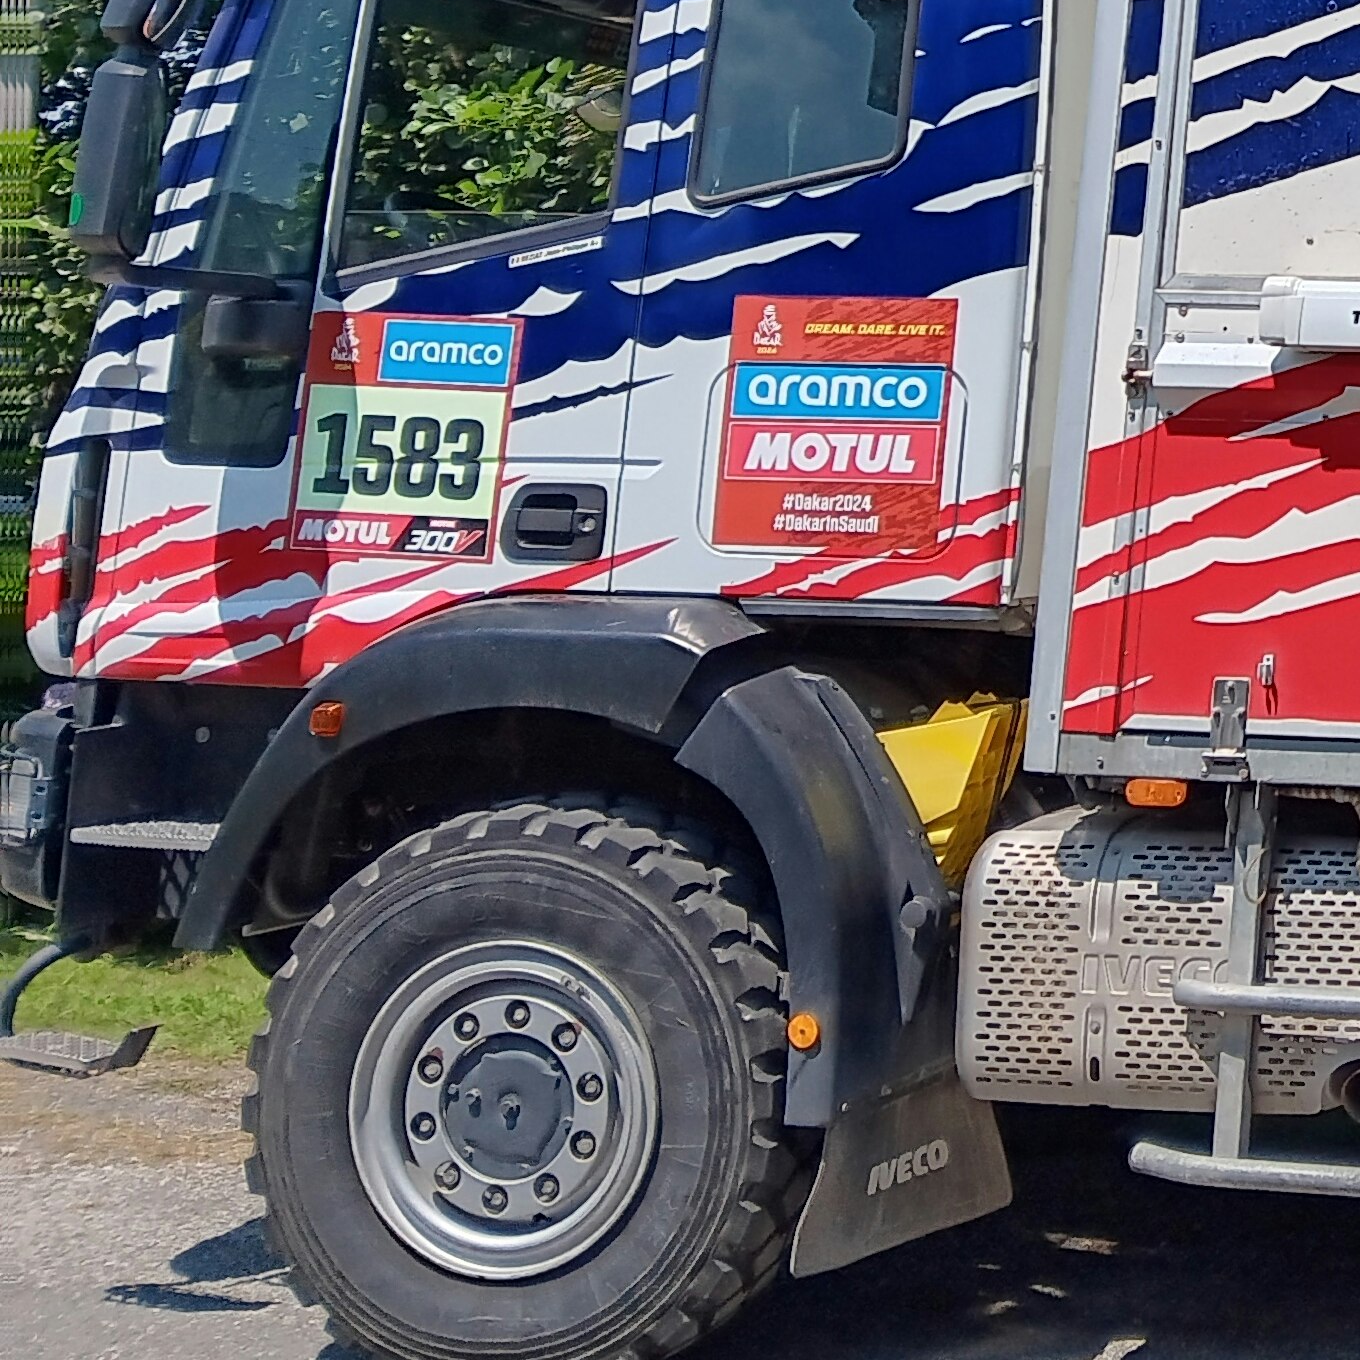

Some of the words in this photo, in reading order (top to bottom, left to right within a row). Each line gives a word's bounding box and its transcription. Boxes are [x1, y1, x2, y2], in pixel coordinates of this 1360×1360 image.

[804, 323, 855, 335] DREAM.
[857, 324, 896, 335] DARE.
[898, 324, 927, 335] LIVE
[929, 325, 946, 335] IT.
[389, 340, 503, 365] aramco
[748, 374, 928, 408] aramco
[312, 413, 484, 500] 1583
[743, 432, 916, 473] MOTUL
[782, 494, 872, 512] #Dakar2024
[298, 519, 392, 544] MOTUL
[773, 514, 880, 533] #DakarInSaudi
[404, 529, 484, 553] 300V
[1080, 953, 1229, 997] IVEC
[867, 1139, 949, 1196] IVECO
